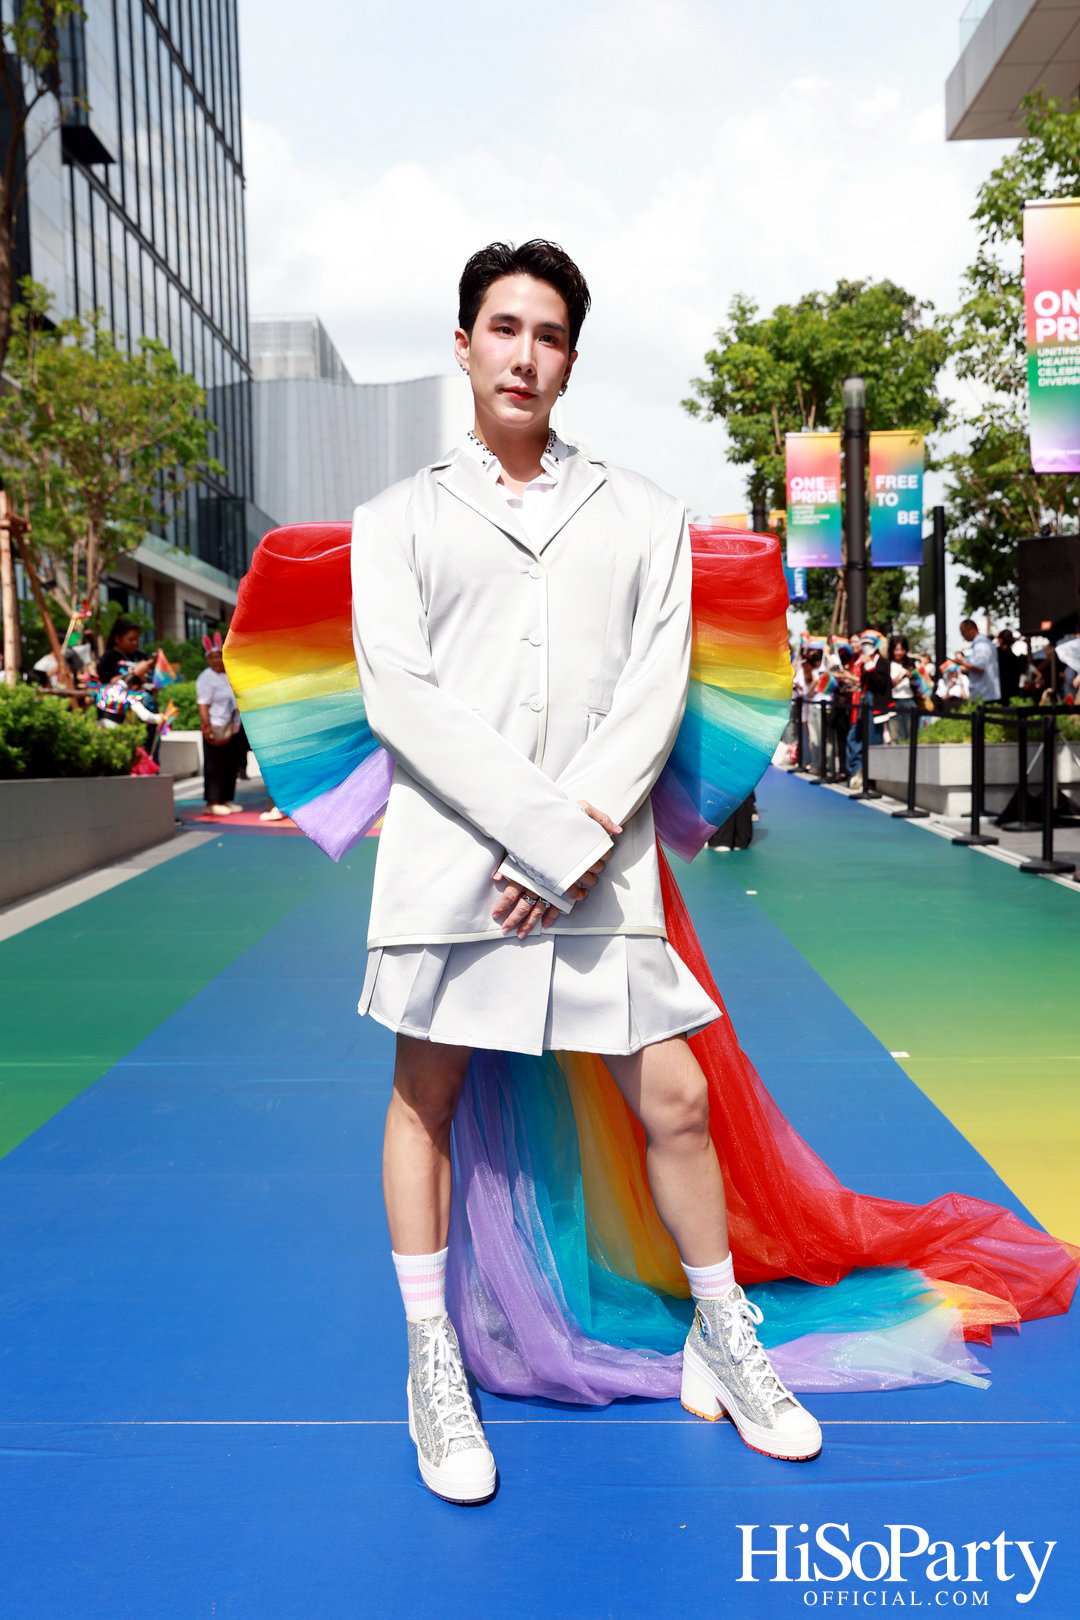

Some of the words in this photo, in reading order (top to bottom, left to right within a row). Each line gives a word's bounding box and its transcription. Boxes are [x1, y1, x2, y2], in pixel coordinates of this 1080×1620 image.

[790, 477, 825, 490] ONE
[875, 475, 918, 489] FREE
[791, 490, 837, 504] PRIDE
[875, 492, 899, 507] TO
[897, 510, 920, 525] BE
